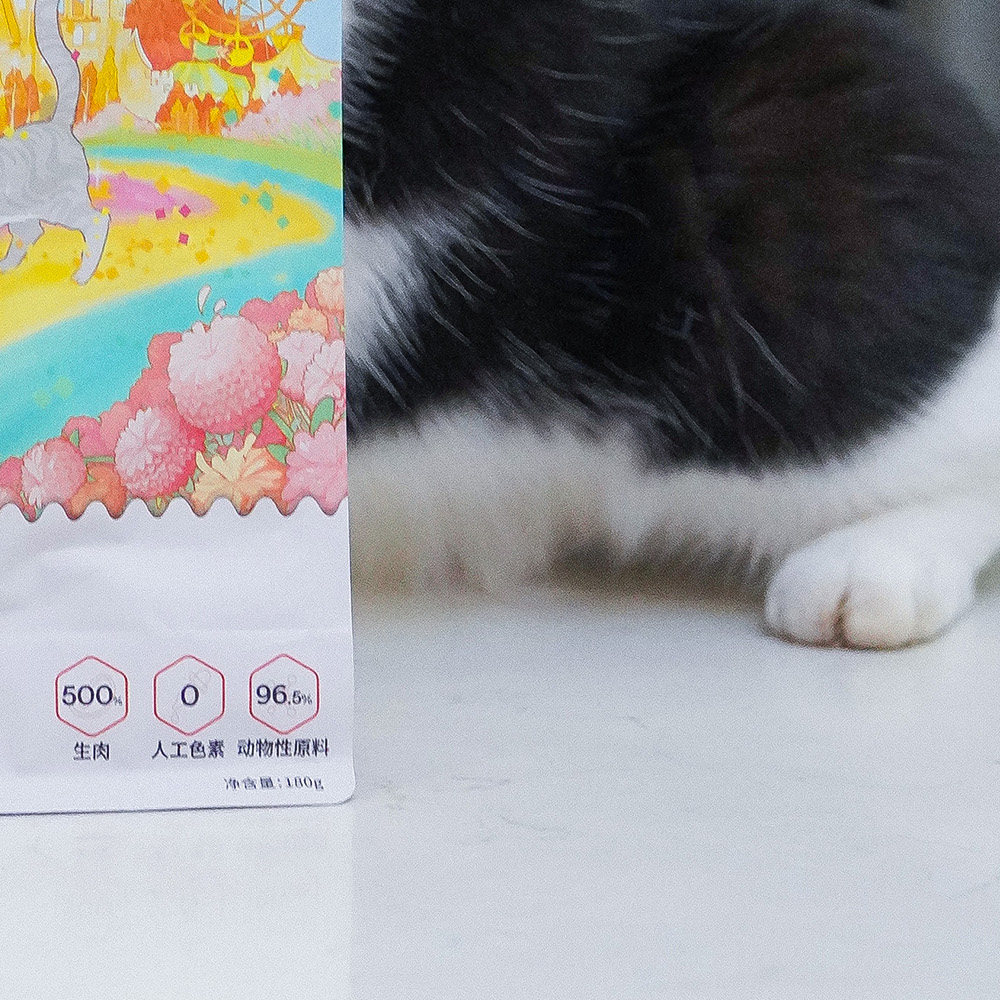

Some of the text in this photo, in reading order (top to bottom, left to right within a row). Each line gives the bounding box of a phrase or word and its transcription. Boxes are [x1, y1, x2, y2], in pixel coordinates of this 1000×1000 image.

[61, 684, 123, 706] 500%
[180, 684, 200, 706] 0
[255, 684, 313, 706] 96.5%
[73, 741, 111, 761] 生肉
[151, 739, 225, 759] 人工色素
[237, 738, 330, 758] 动物性原料
